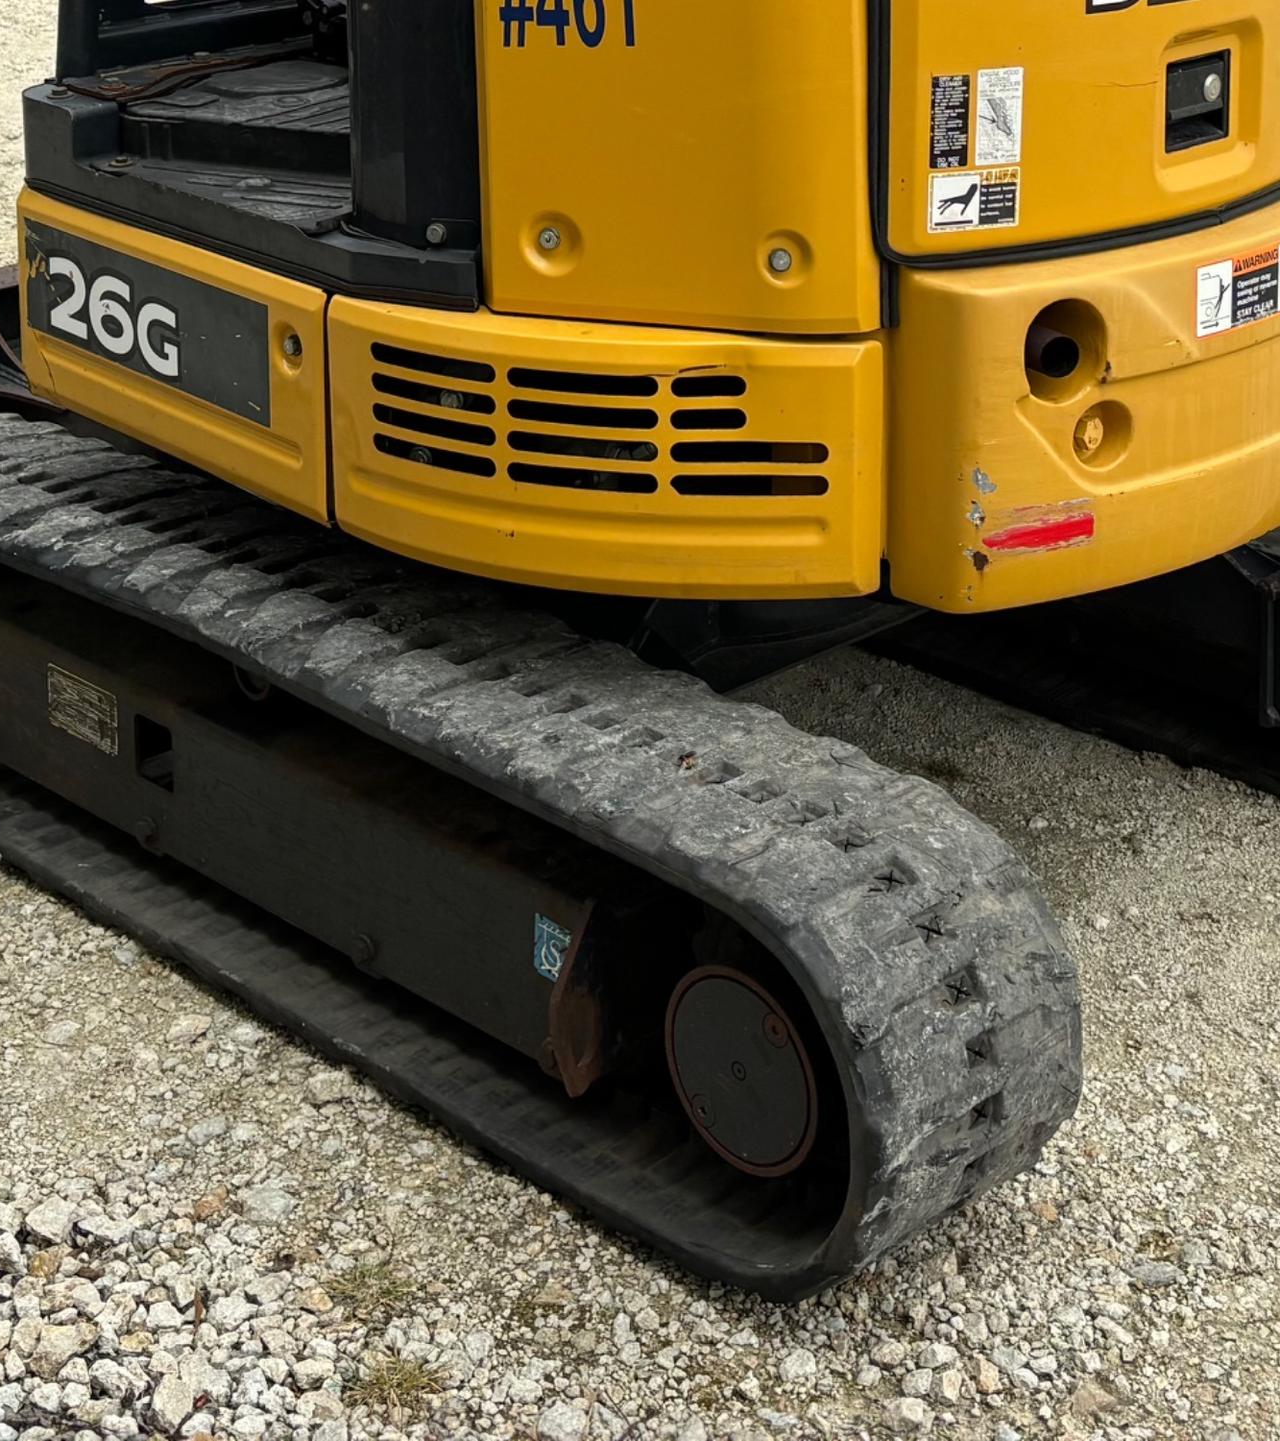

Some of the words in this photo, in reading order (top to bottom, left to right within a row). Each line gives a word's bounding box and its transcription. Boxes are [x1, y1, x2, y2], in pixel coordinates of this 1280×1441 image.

[1242, 248, 1279, 270] WARNING
[48, 256, 180, 378] 26G
[1236, 307, 1252, 319] STAY
[1253, 300, 1274, 313] CLEAR
